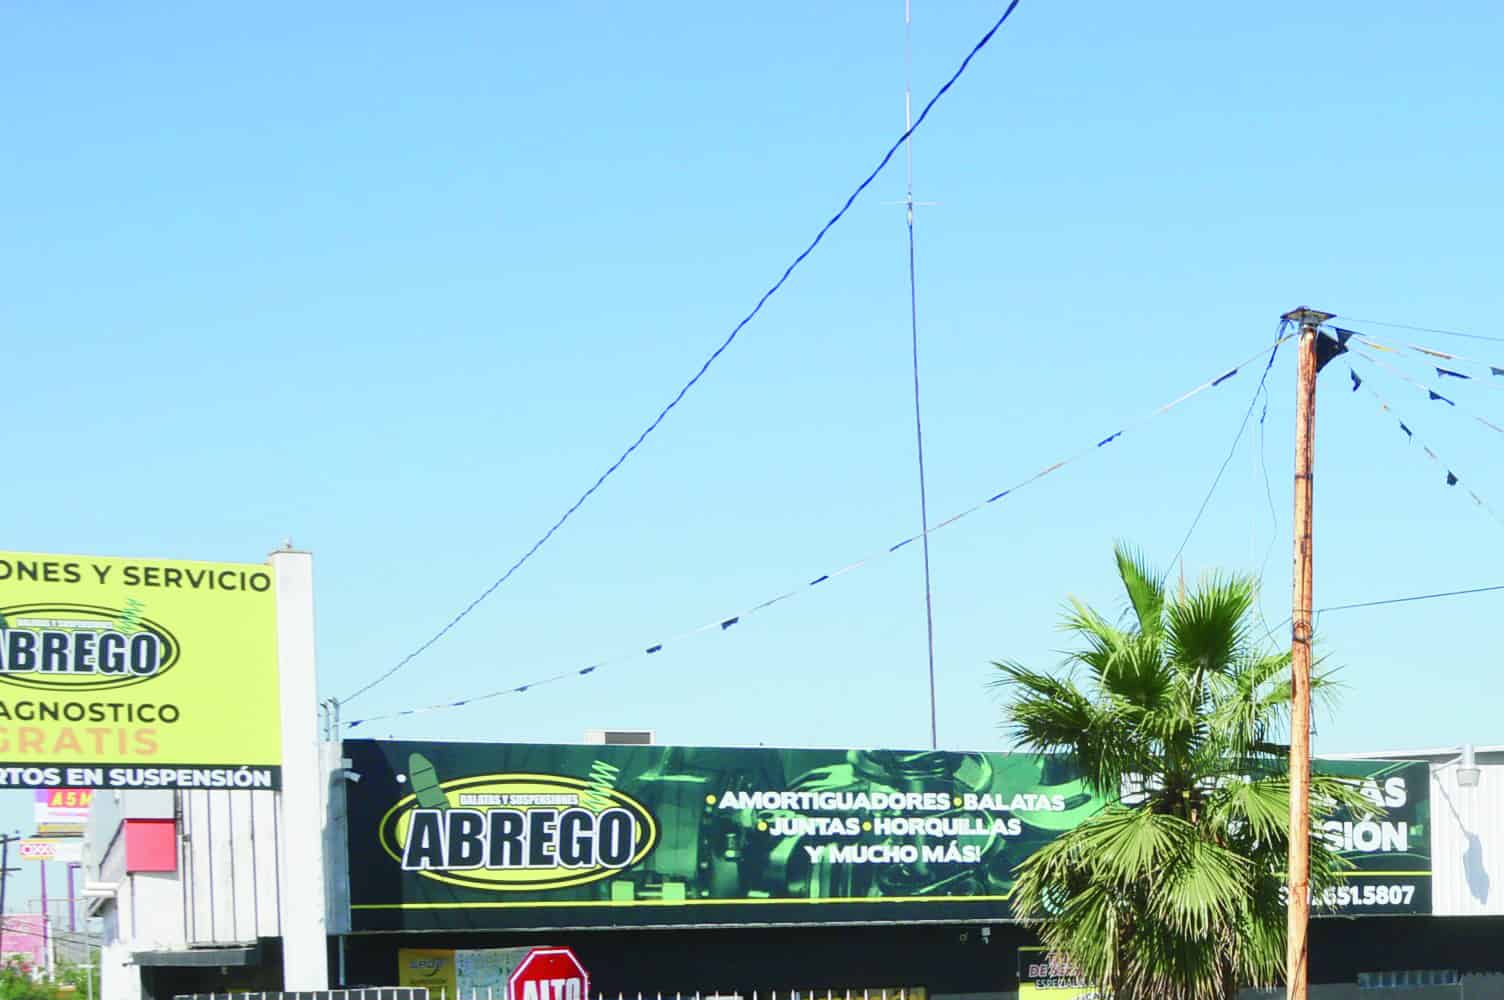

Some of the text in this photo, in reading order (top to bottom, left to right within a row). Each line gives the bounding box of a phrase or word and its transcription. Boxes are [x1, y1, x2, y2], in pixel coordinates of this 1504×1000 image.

[94, 565, 112, 584] Y
[124, 566, 271, 592] SERVICIO
[0, 629, 161, 677] BREGO
[67, 768, 104, 786] EN
[110, 766, 272, 787] SUSPENSIÓN
[719, 791, 1066, 811] AMORTIGUADORES BALATAS
[402, 807, 636, 871] ABREGO
[769, 817, 1022, 838] JUNTAS HORQUILLAS
[804, 840, 982, 863] Y MUCHO MÁS!
